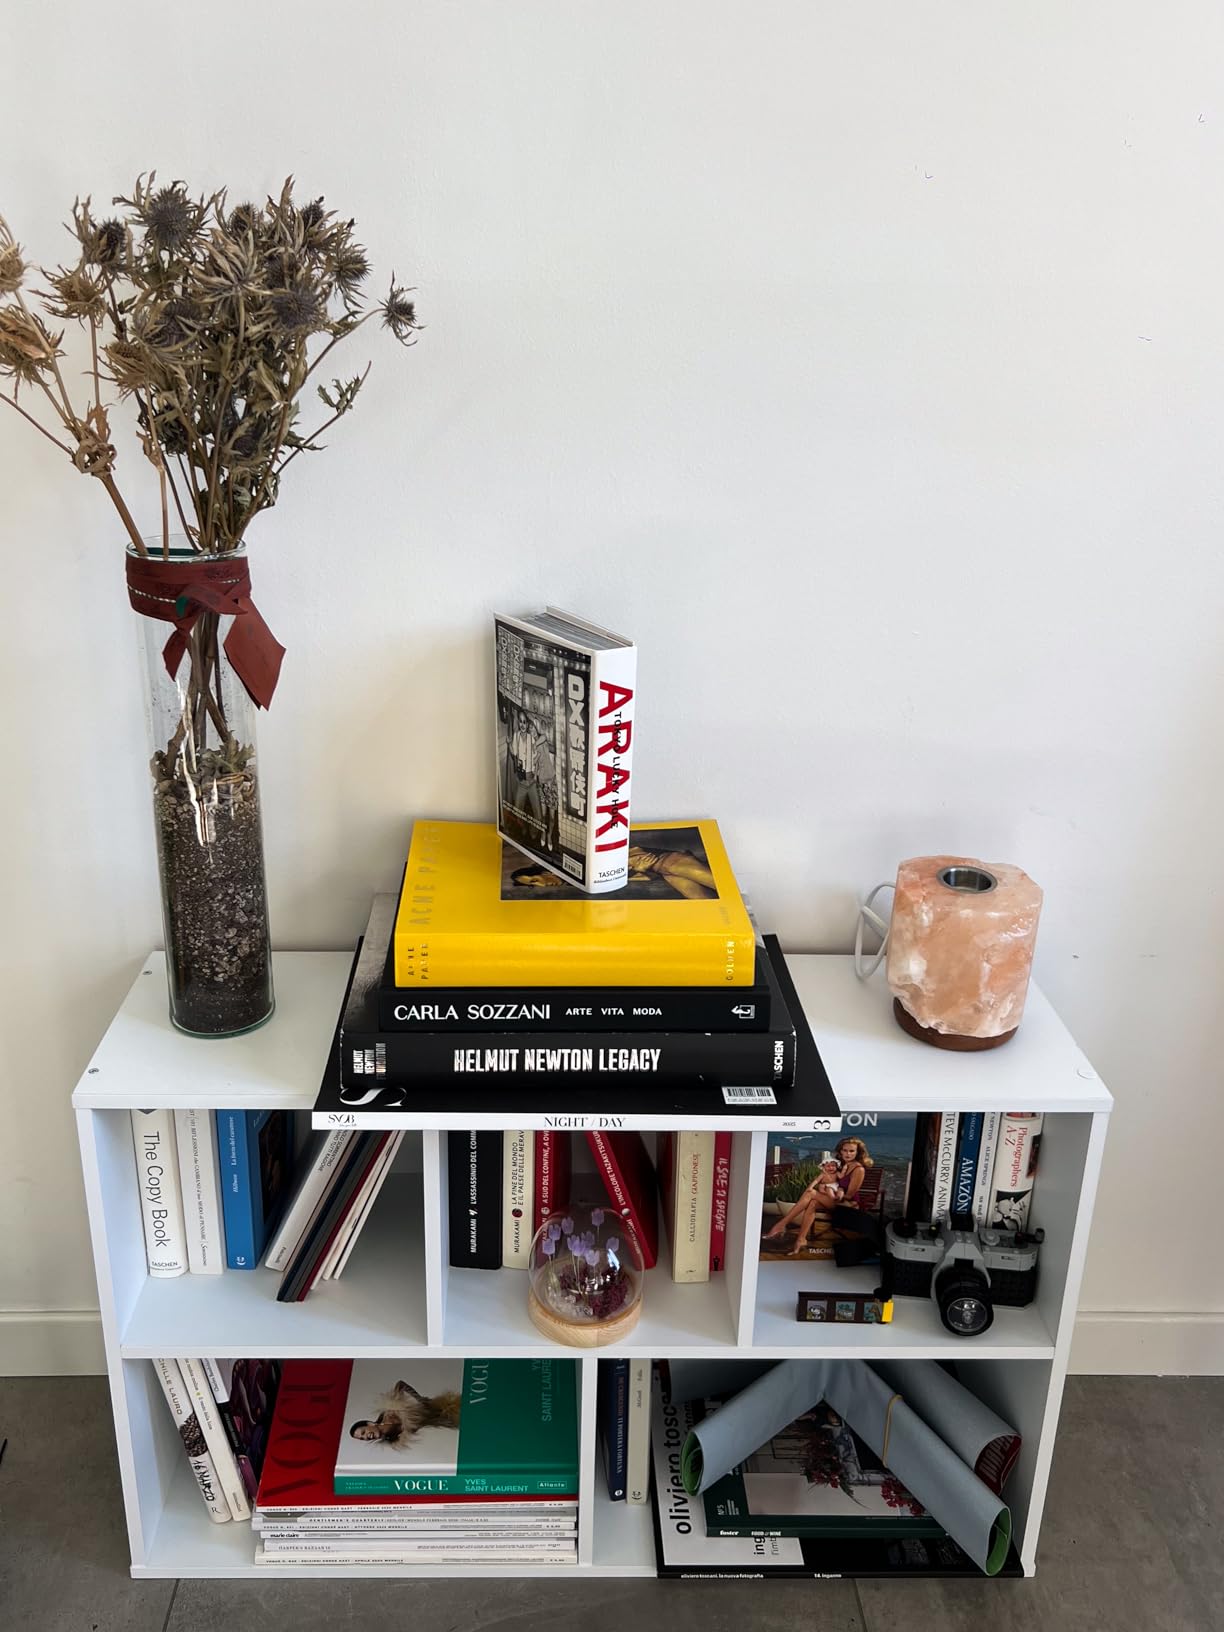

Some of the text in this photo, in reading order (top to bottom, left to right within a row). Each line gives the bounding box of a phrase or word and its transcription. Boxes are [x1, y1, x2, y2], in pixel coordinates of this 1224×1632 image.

[595, 680, 633, 853] ARAKI
[610, 711, 623, 829] TOKYO LUCKY HOLE
[598, 867, 625, 878] TASCHEN
[393, 1004, 662, 1021] CARLA SOZZANI ARTE VITA MODA
[353, 1050, 364, 1074] HELMUT
[364, 1049, 375, 1075] NEWTON
[453, 1048, 661, 1073] HELMUT NEWTON LEGACY
[773, 1040, 784, 1080] TASCHEN
[544, 1117, 588, 1128] NIGHT
[599, 1117, 626, 1128] DAY
[943, 1112, 956, 1135] TEVE
[986, 1116, 996, 1141] NEWTON
[1004, 1125, 1017, 1146] A-Z
[326, 1140, 342, 1167] SORRENTINO
[542, 1146, 550, 1174] CONFINE,
[939, 1137, 953, 1184] McCURRY
[983, 1145, 991, 1162] ALICE
[1010, 1127, 1028, 1187] Photographers
[143, 1131, 172, 1248] The Copy Book
[608, 1174, 626, 1206] L'INCOLORE
[956, 1157, 974, 1215] AMAZÔNI
[980, 1162, 989, 1187] SPRINGS
[511, 1196, 518, 1205] LA
[689, 1152, 700, 1242] CALLIGRAFIA GIAPPONESE
[714, 1199, 726, 1232] SPEGNE
[159, 1358, 183, 1416] CHILLE LAURO
[468, 1359, 489, 1404] VOGU
[541, 1359, 553, 1422] SAINT LAURE
[261, 1382, 336, 1500] VOGU
[196, 1471, 216, 1502] MARZO
[394, 1479, 449, 1491] VOGUE
[666, 1452, 691, 1535] oliviero
